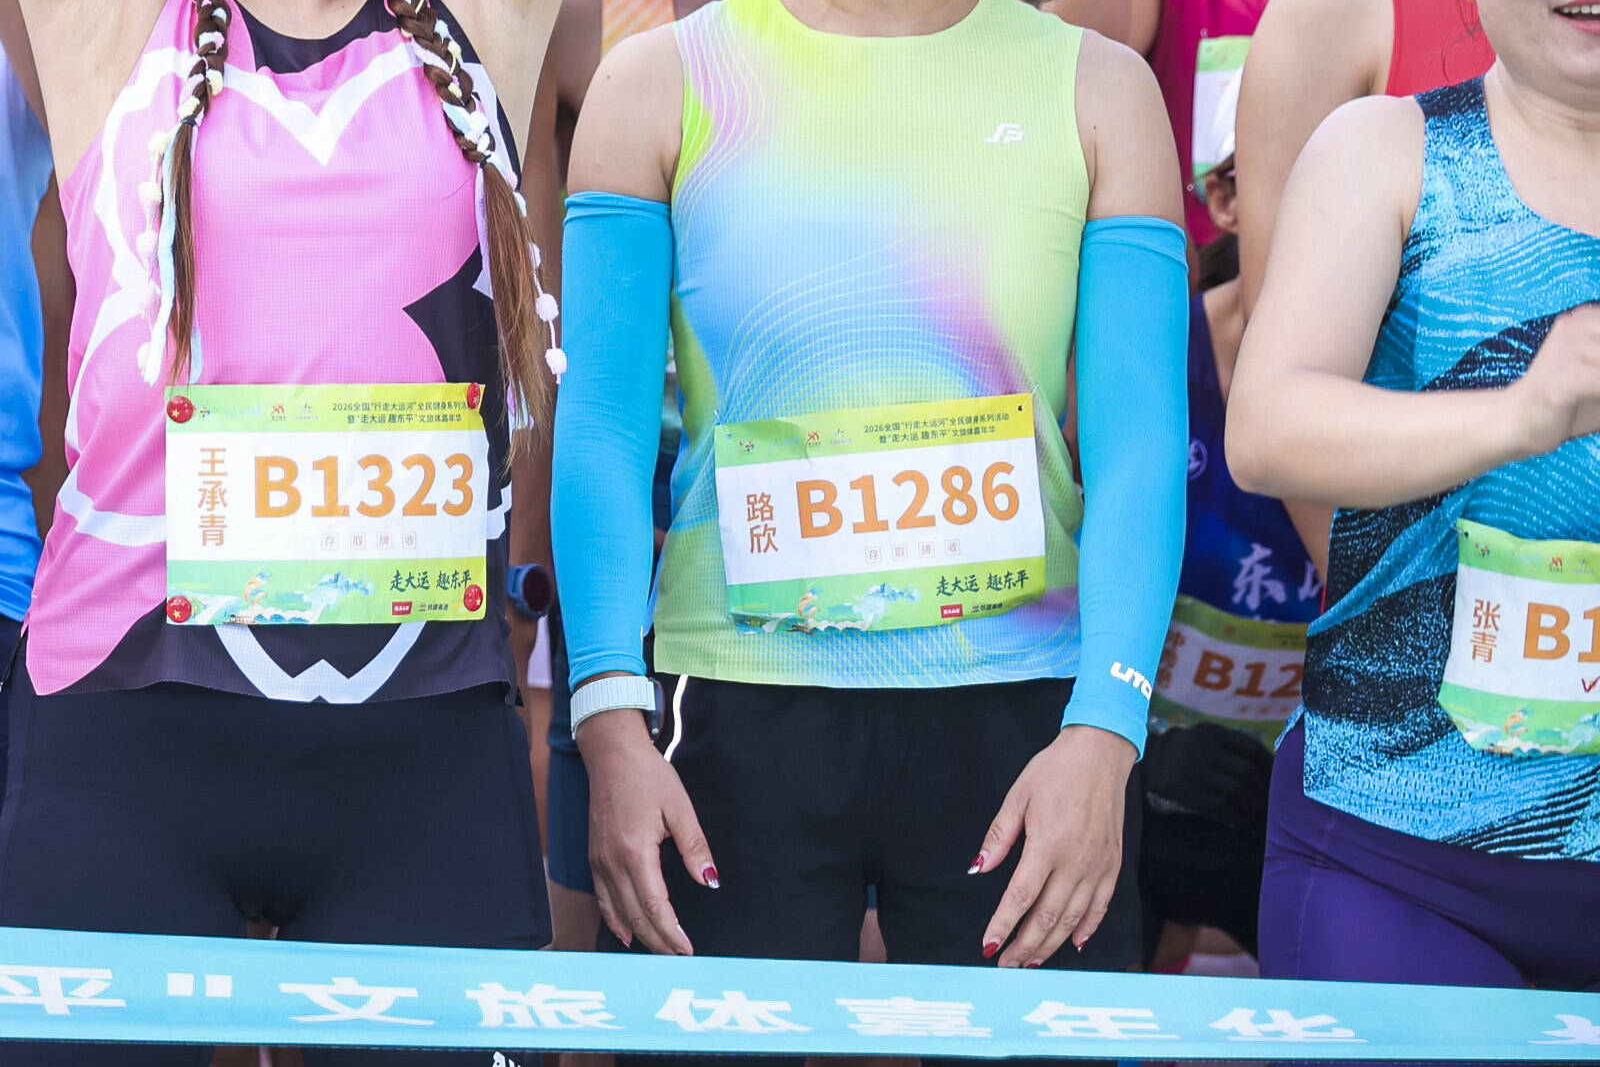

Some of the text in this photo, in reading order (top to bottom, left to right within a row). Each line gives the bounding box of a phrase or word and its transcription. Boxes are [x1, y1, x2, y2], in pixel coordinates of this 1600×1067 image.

[197, 447, 228, 547] 王承青
[255, 452, 474, 518] B1323
[796, 461, 1020, 539] B1286
[746, 492, 779, 554] 路欣
[390, 569, 472, 592] 走大运 趣东平
[936, 569, 1029, 597] 走大运 趣东平
[1470, 598, 1501, 663] 张青
